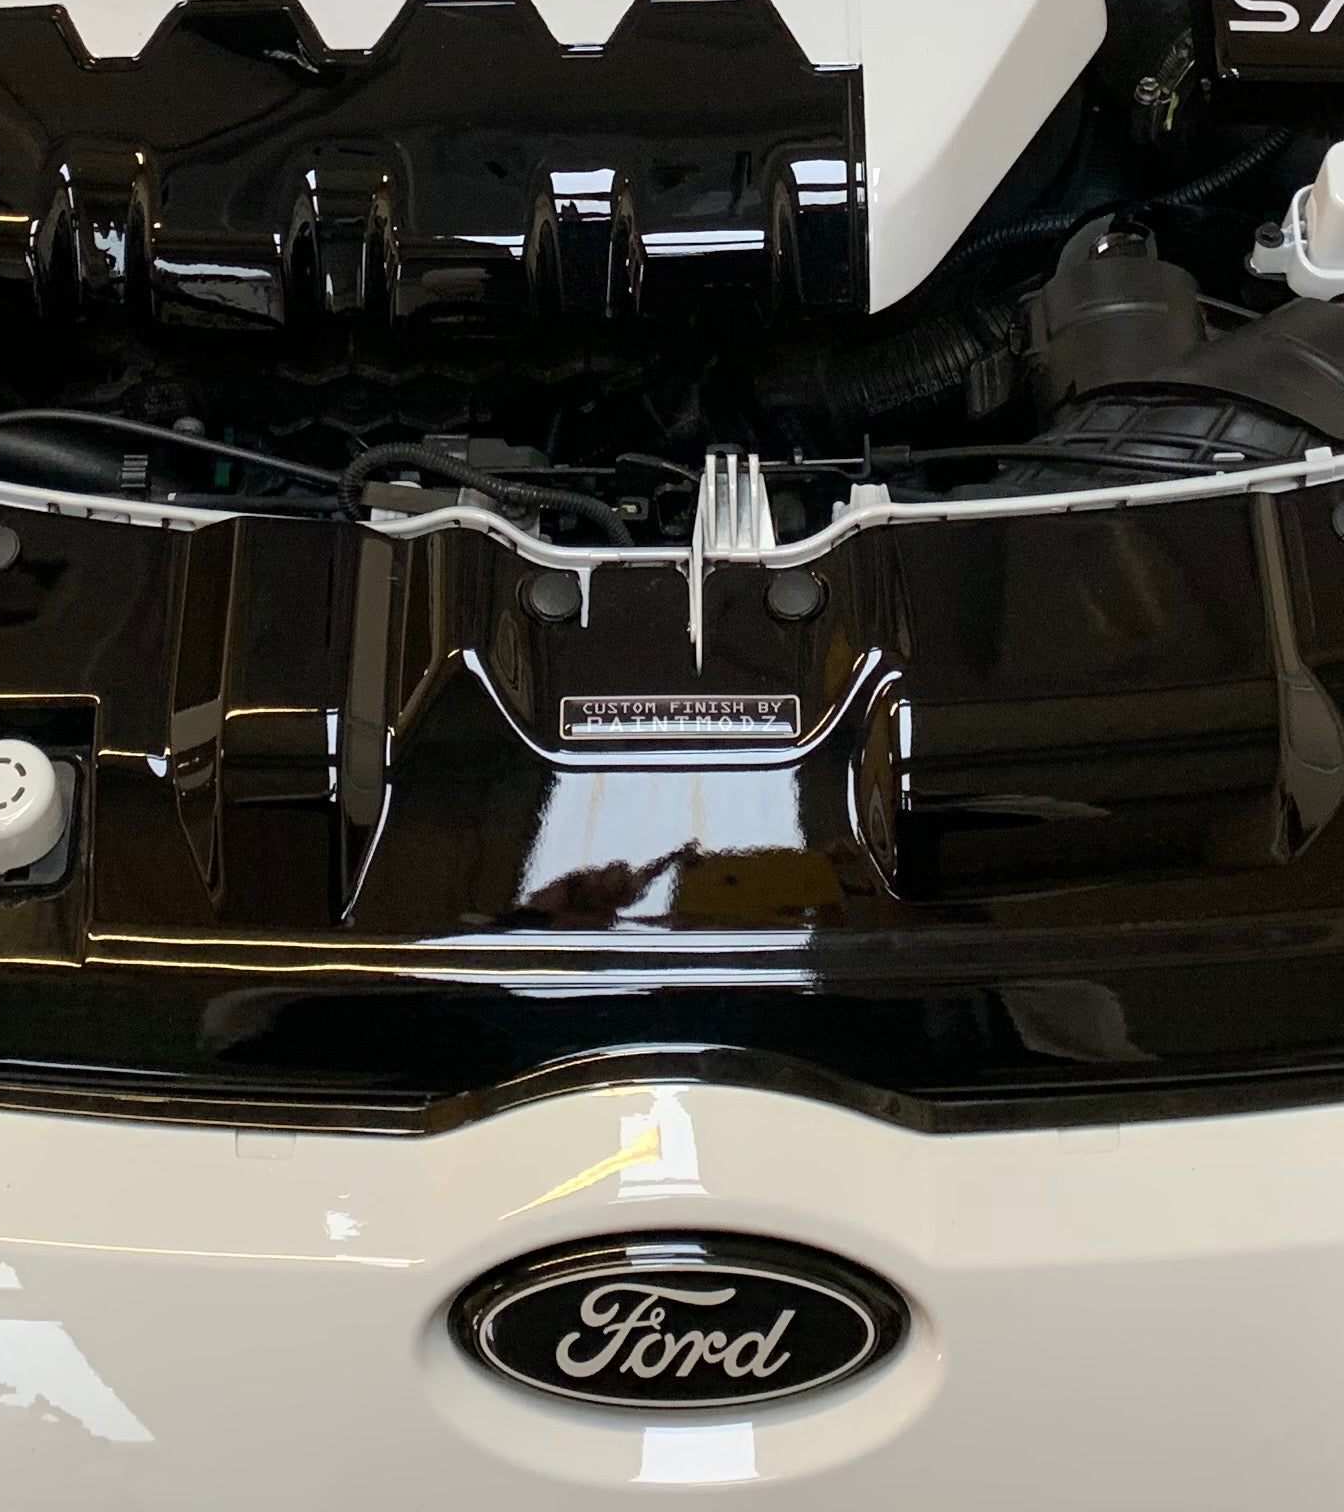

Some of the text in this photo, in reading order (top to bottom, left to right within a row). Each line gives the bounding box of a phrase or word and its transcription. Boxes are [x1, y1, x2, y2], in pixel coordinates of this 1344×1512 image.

[582, 701, 782, 714] CUSTOM FINISH BY
[587, 715, 778, 733] PAINTMODZ
[556, 1282, 796, 1379] Ford
